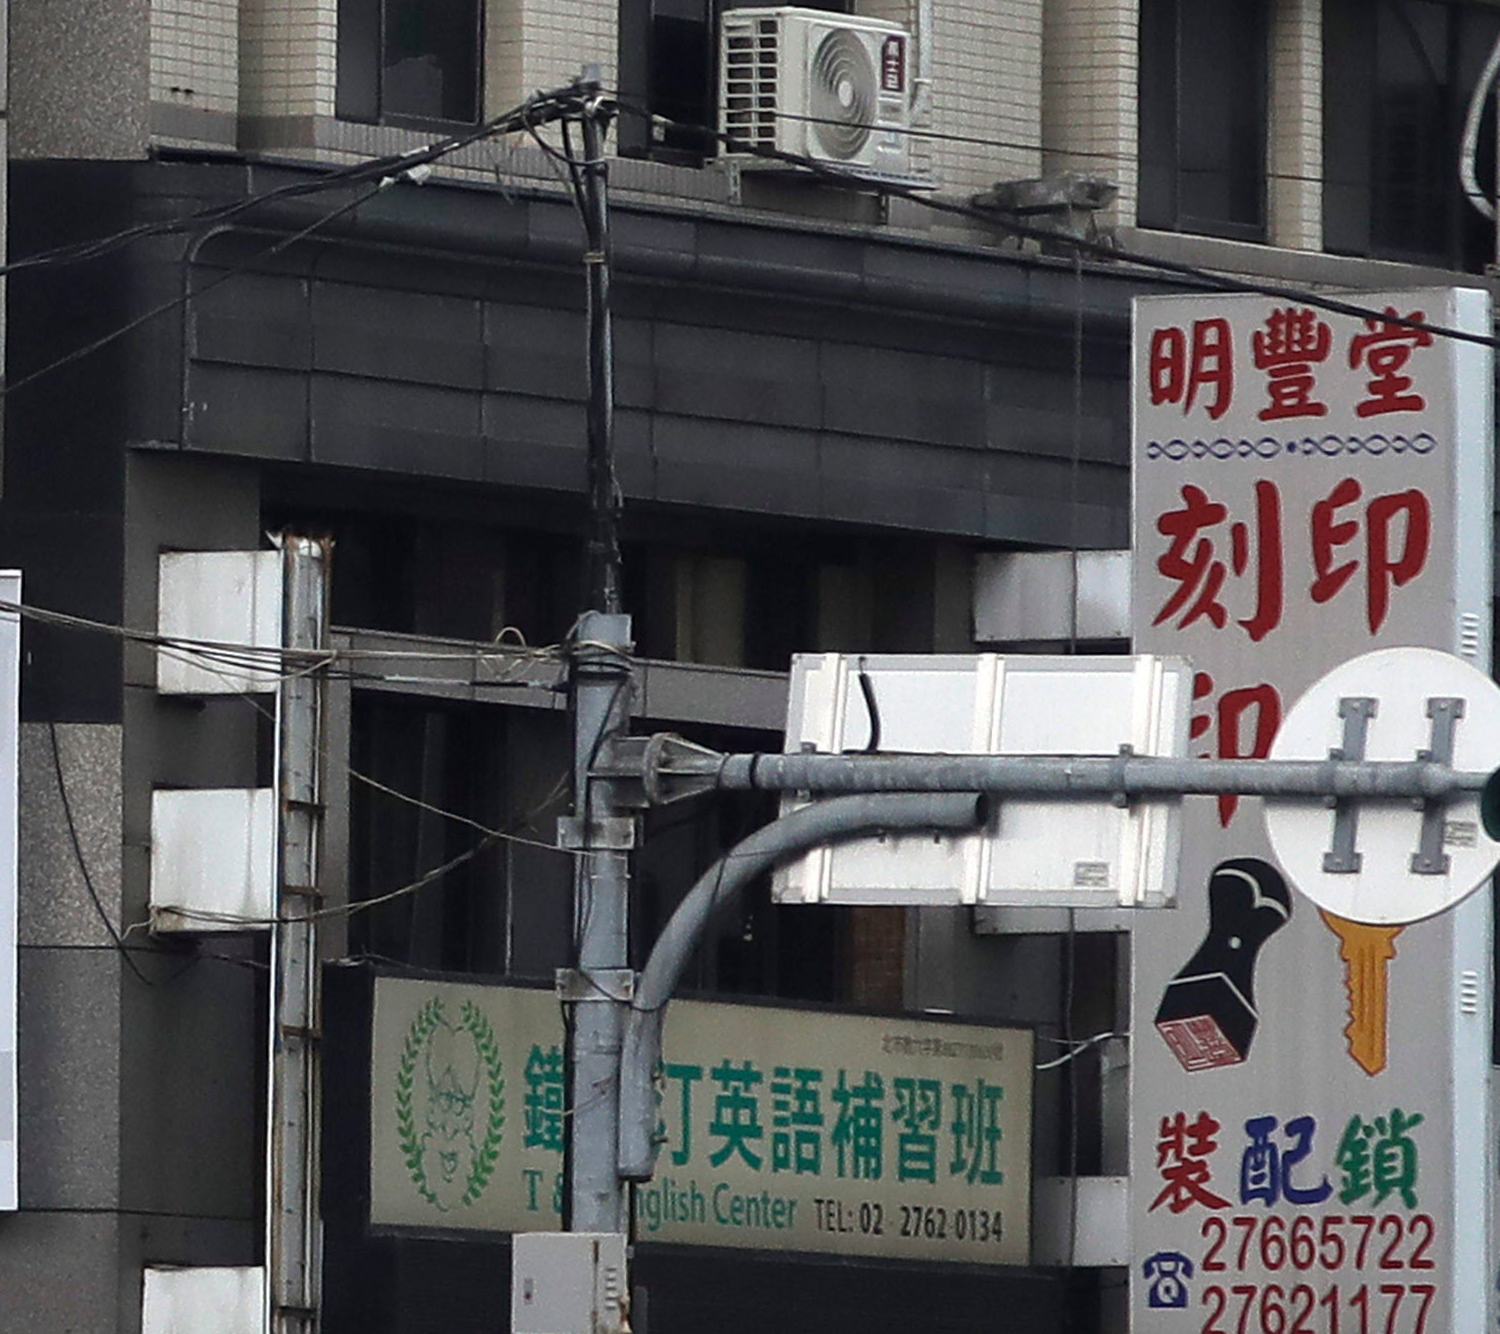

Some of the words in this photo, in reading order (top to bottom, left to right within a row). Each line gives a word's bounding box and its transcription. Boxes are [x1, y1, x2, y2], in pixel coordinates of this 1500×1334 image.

[1148, 306, 1434, 423] 明豐堂
[1153, 478, 1431, 642] 刻印
[714, 1183, 797, 1230] Center
[814, 1198, 854, 1234] TEL:
[1147, 1107, 1424, 1214] 裝配鎖
[1202, 1215, 1435, 1270] 27665722
